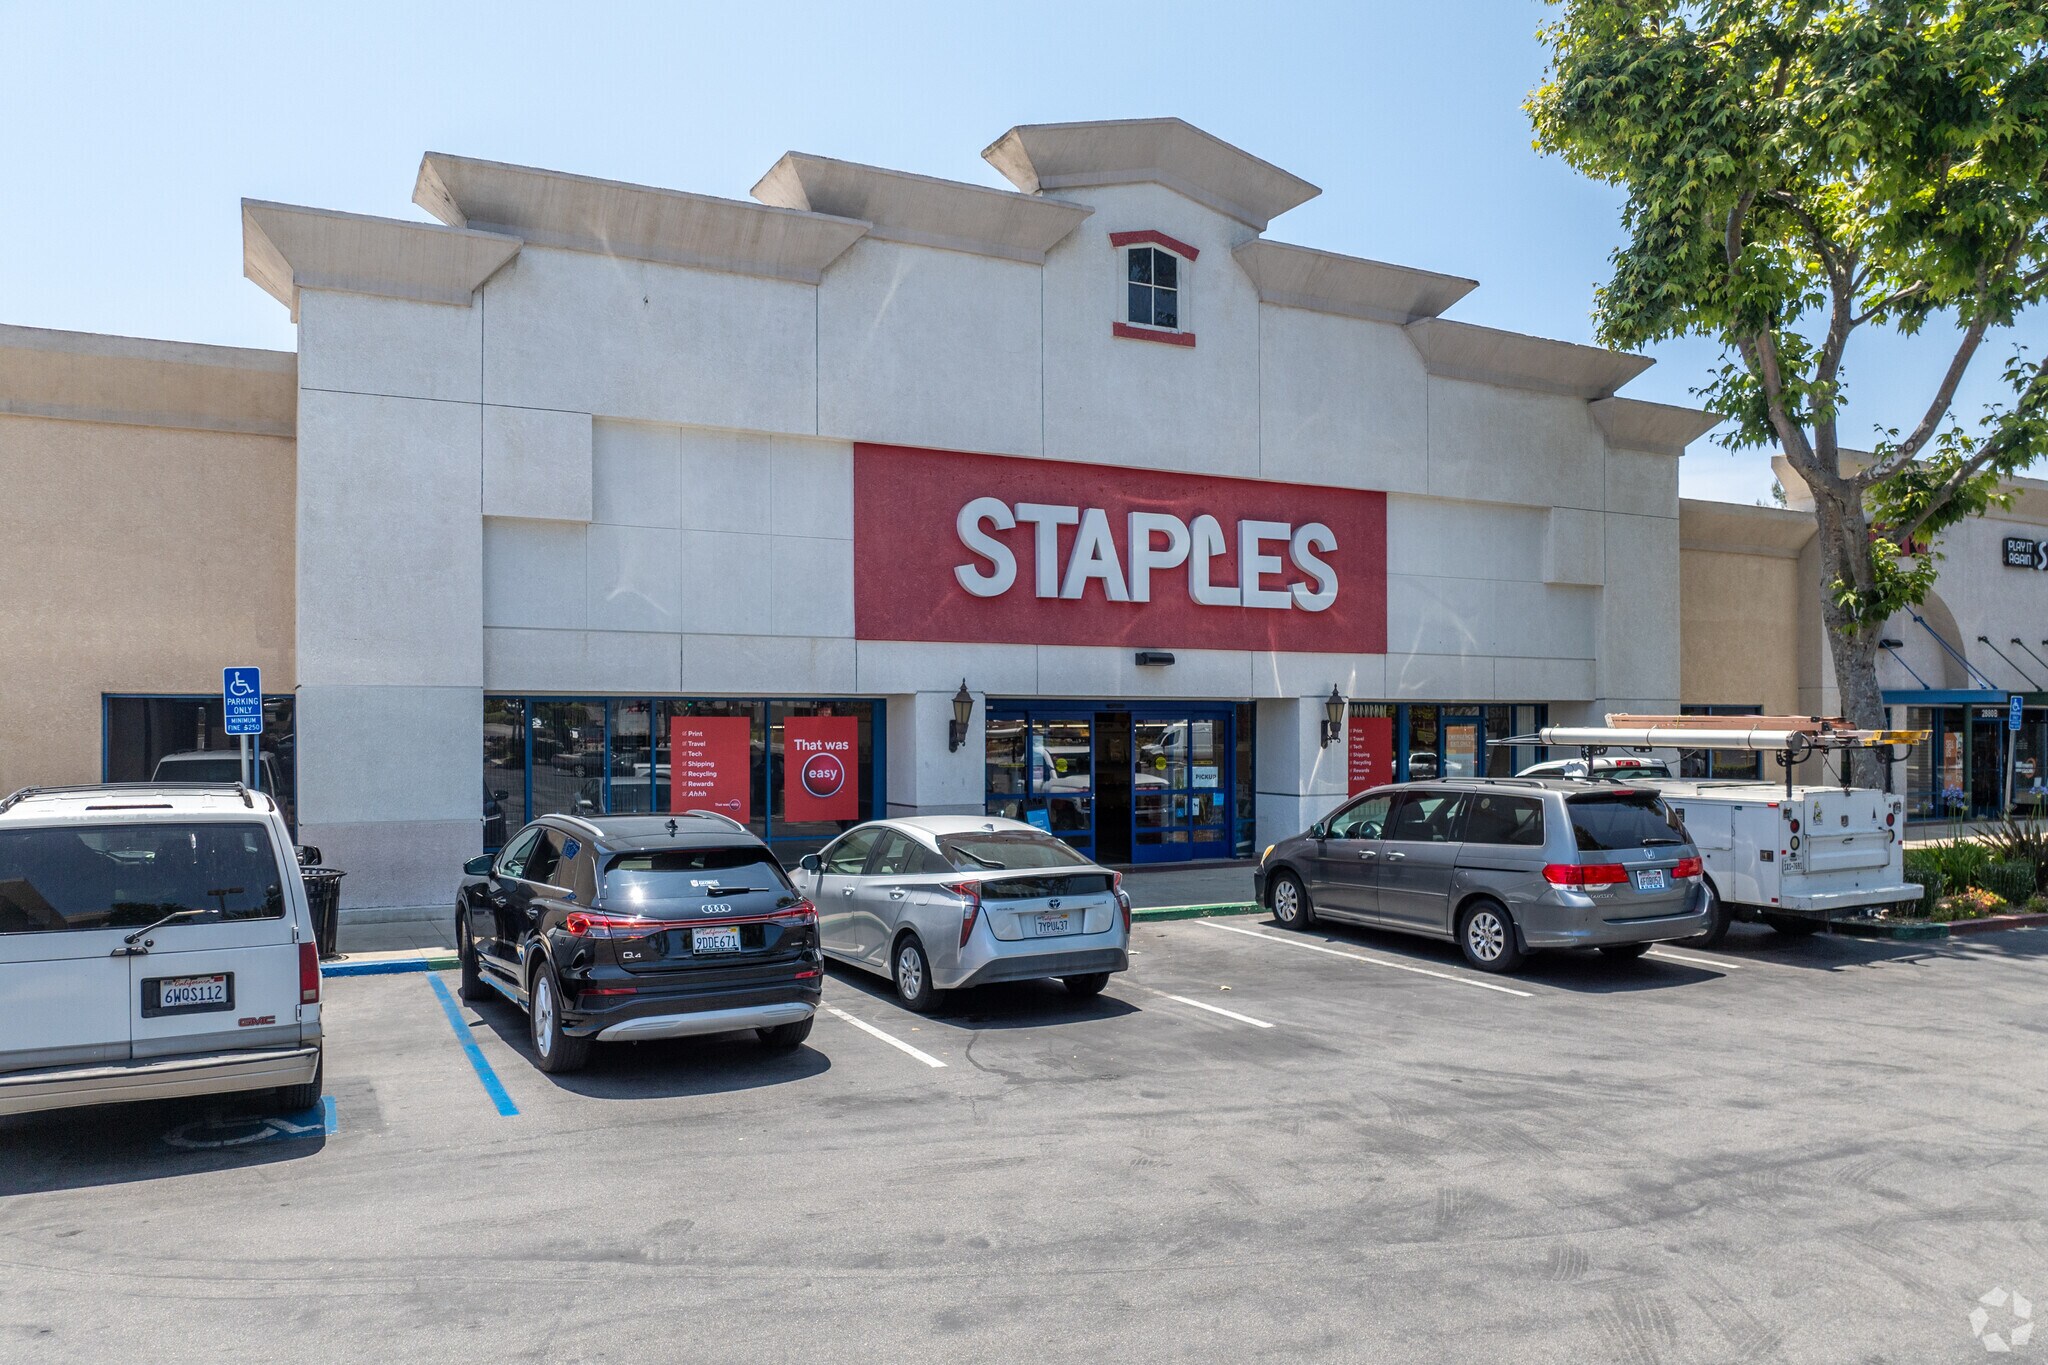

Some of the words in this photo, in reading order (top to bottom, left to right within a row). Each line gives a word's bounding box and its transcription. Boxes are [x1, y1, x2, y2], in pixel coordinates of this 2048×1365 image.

[2008, 540, 2026, 552] PLAY
[2026, 542, 2033, 553] IT
[954, 496, 1339, 612] STAPLES
[2008, 552, 2032, 565] AGAIN
[227, 697, 259, 705] PARKING
[233, 706, 252, 714] ONLY
[794, 739, 822, 751] That
[825, 741, 849, 750] was
[808, 769, 838, 781] easy
[1038, 920, 1067, 932] 7YPU437
[696, 935, 737, 949] 9DDE671
[623, 951, 641, 959] Q4
[174, 979, 214, 987] California
[165, 985, 222, 1003] 6WQS112
[238, 1015, 275, 1027] GMC
